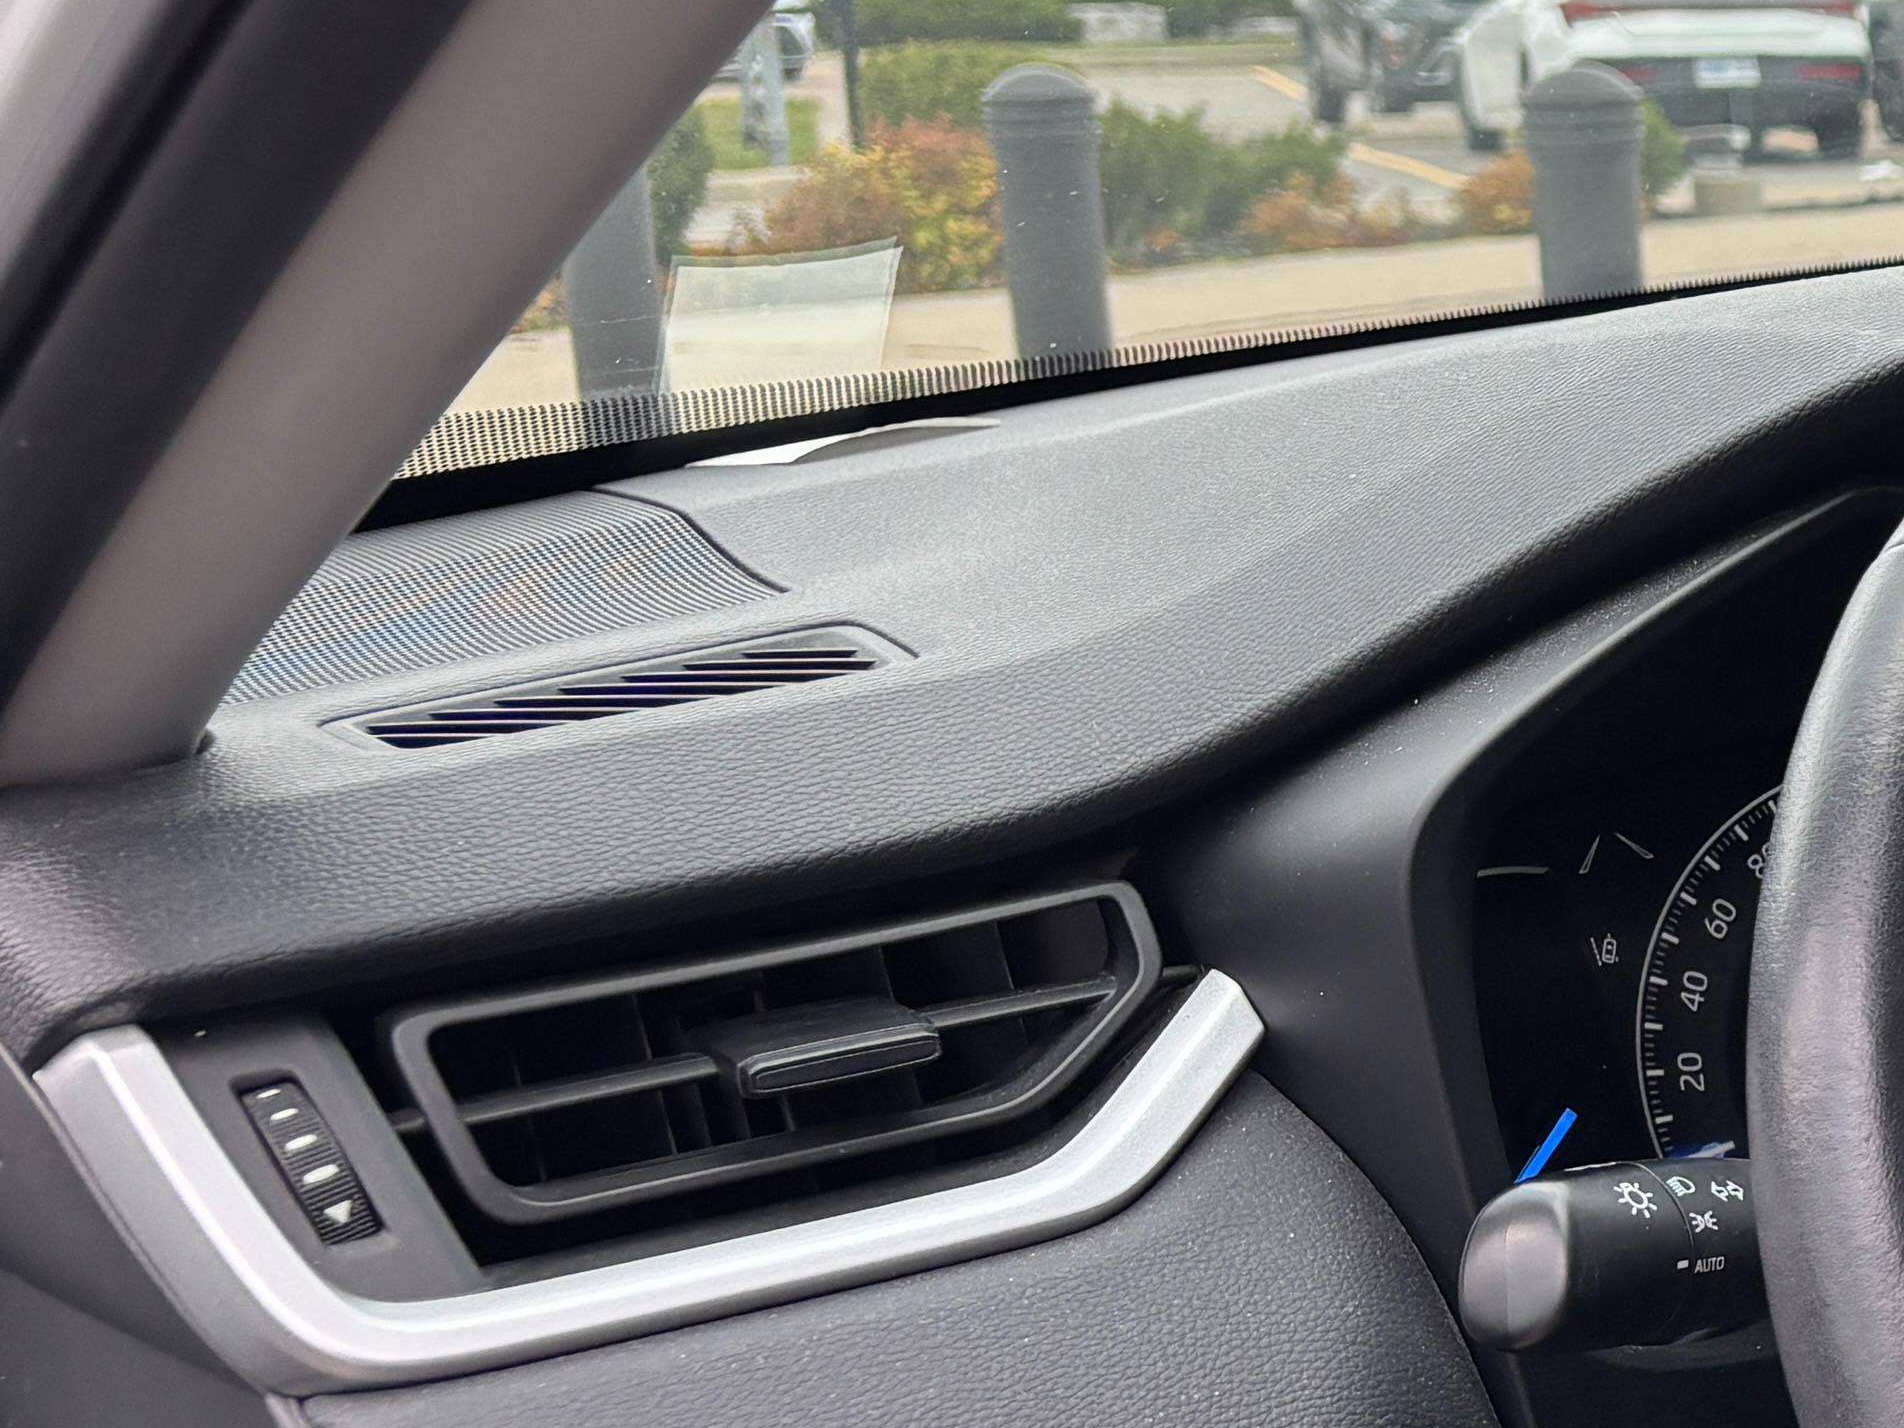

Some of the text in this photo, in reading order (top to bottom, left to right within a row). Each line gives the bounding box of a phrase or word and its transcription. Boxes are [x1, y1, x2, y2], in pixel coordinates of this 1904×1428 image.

[1704, 898, 1737, 940] 60
[1679, 970, 1709, 1013] 40
[1676, 1051, 1706, 1092] 20
[1693, 1255, 1725, 1274] AUTO
